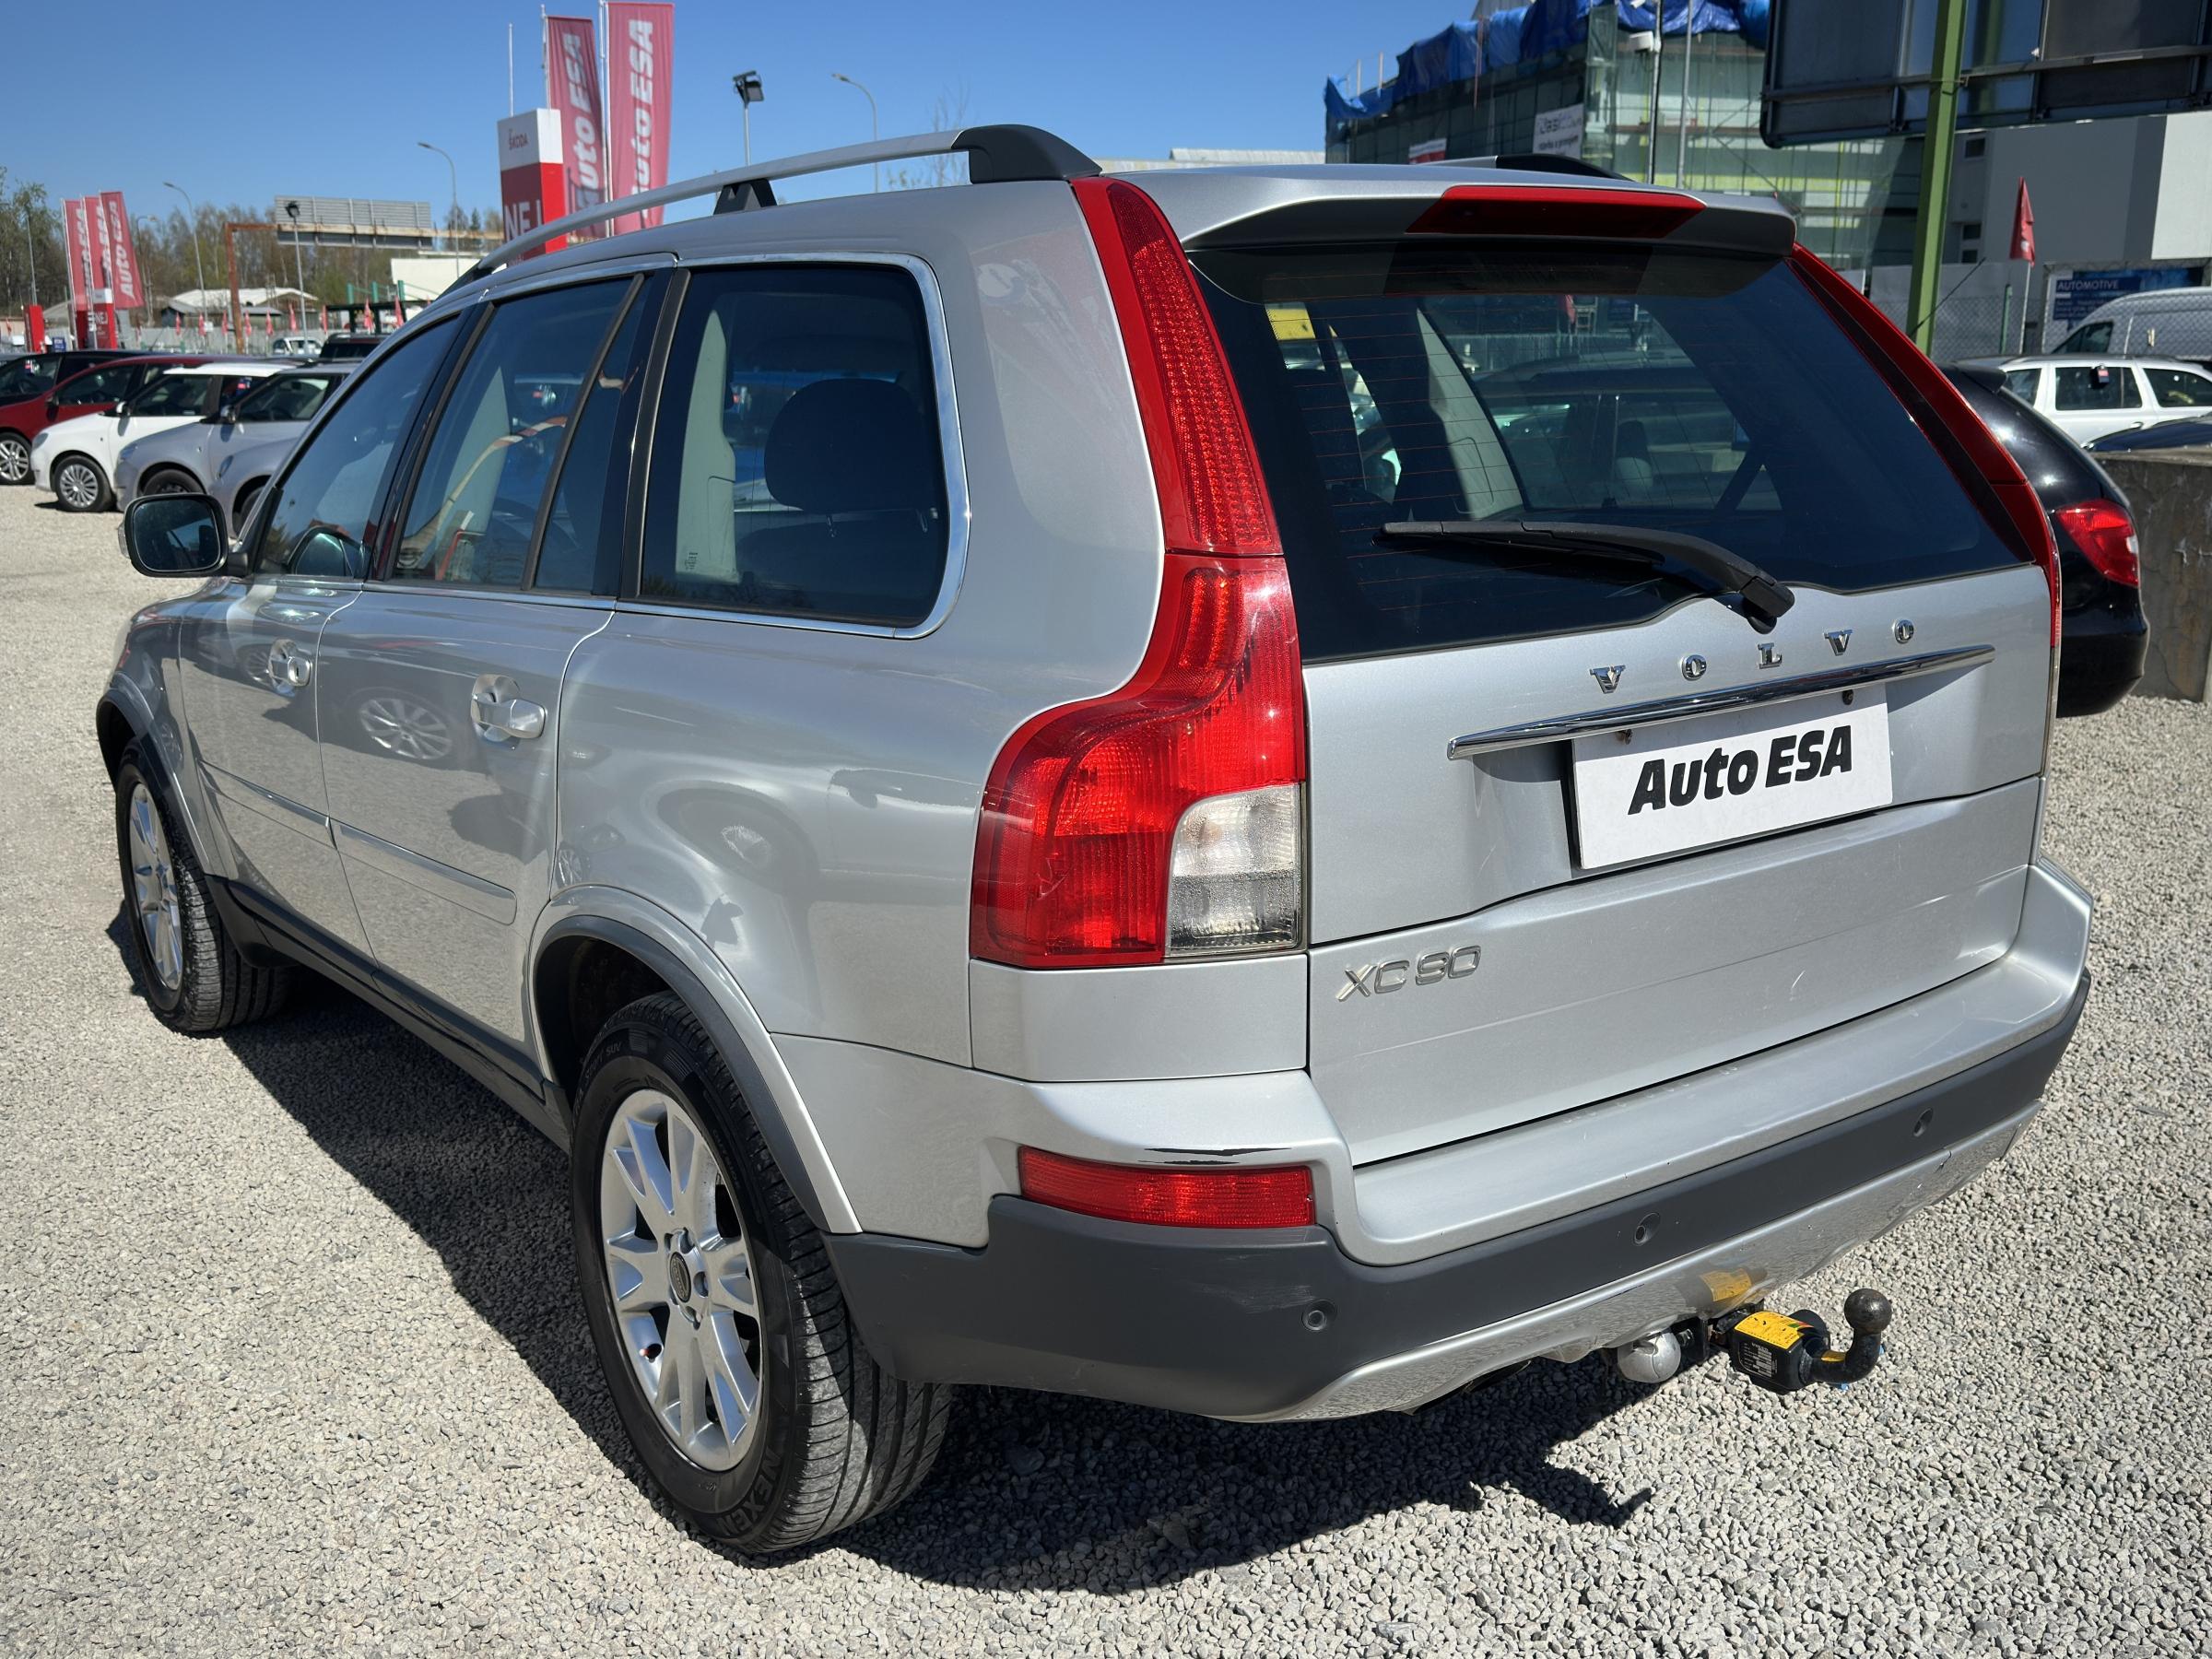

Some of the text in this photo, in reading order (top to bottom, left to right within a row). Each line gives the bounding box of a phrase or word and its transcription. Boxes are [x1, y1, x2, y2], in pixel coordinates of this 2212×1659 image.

[563, 32, 592, 113] ESA
[629, 19, 653, 105] ESA
[2057, 279, 2119, 290] AUTOMOTIVE
[1589, 619, 1915, 694] VOLVO
[1627, 724, 1853, 816] Auto ESA
[716, 1445, 782, 1535] NEXEN
